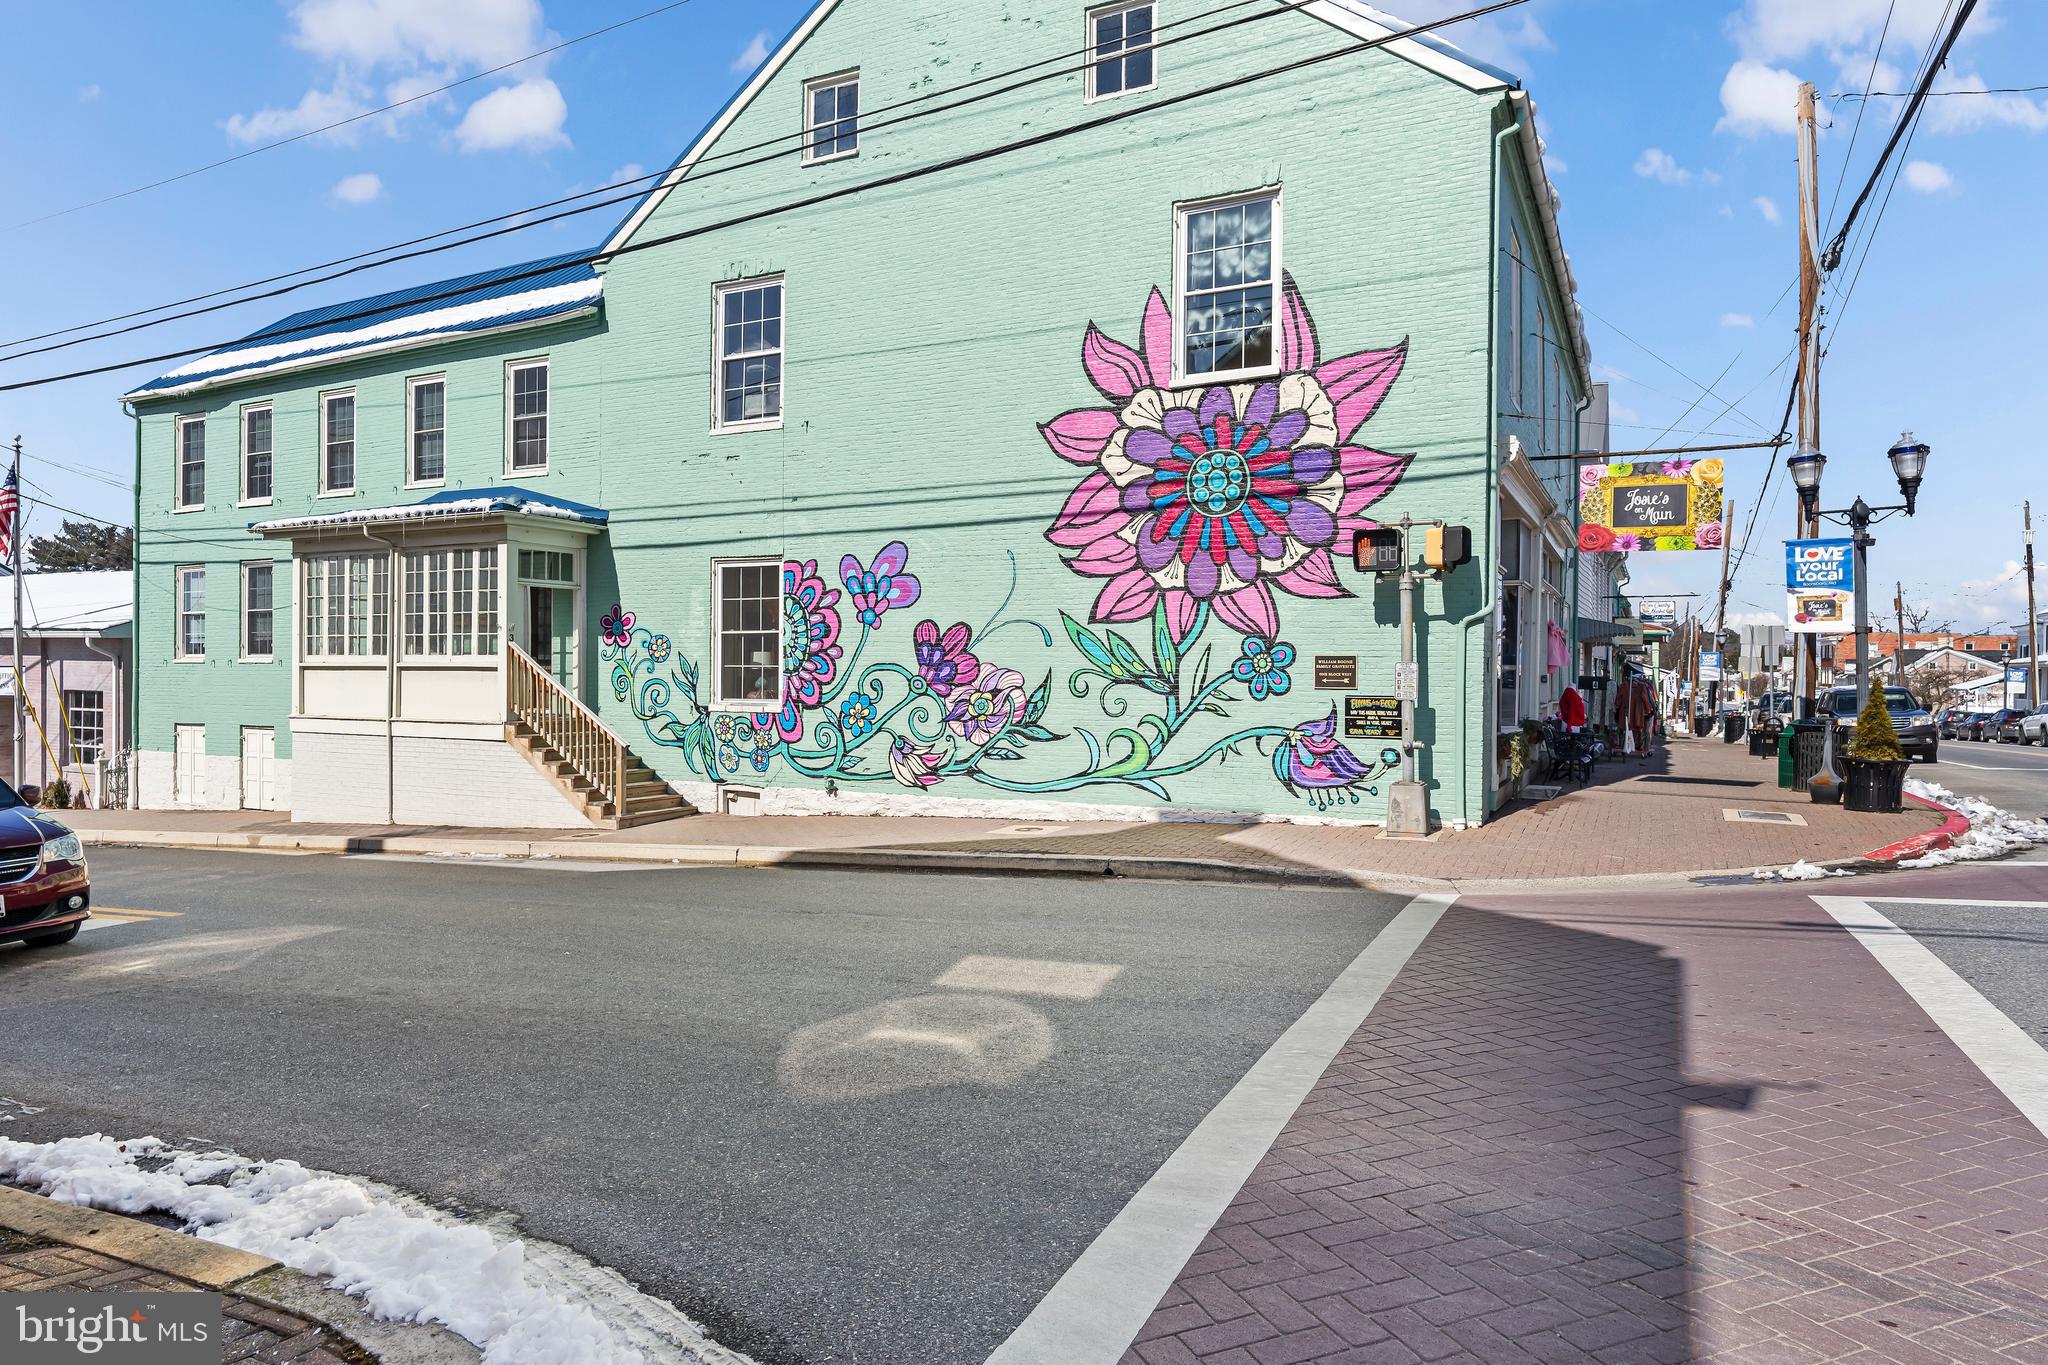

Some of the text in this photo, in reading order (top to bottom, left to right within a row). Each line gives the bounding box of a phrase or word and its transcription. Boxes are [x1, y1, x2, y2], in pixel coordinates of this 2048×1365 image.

[1624, 488, 1670, 511] Josie's
[1634, 506, 1676, 525] on Main
[1794, 546, 1845, 563] LOVE
[1800, 561, 1839, 573] your
[1796, 568, 1844, 582] Local
[509, 633, 514, 642] 3
